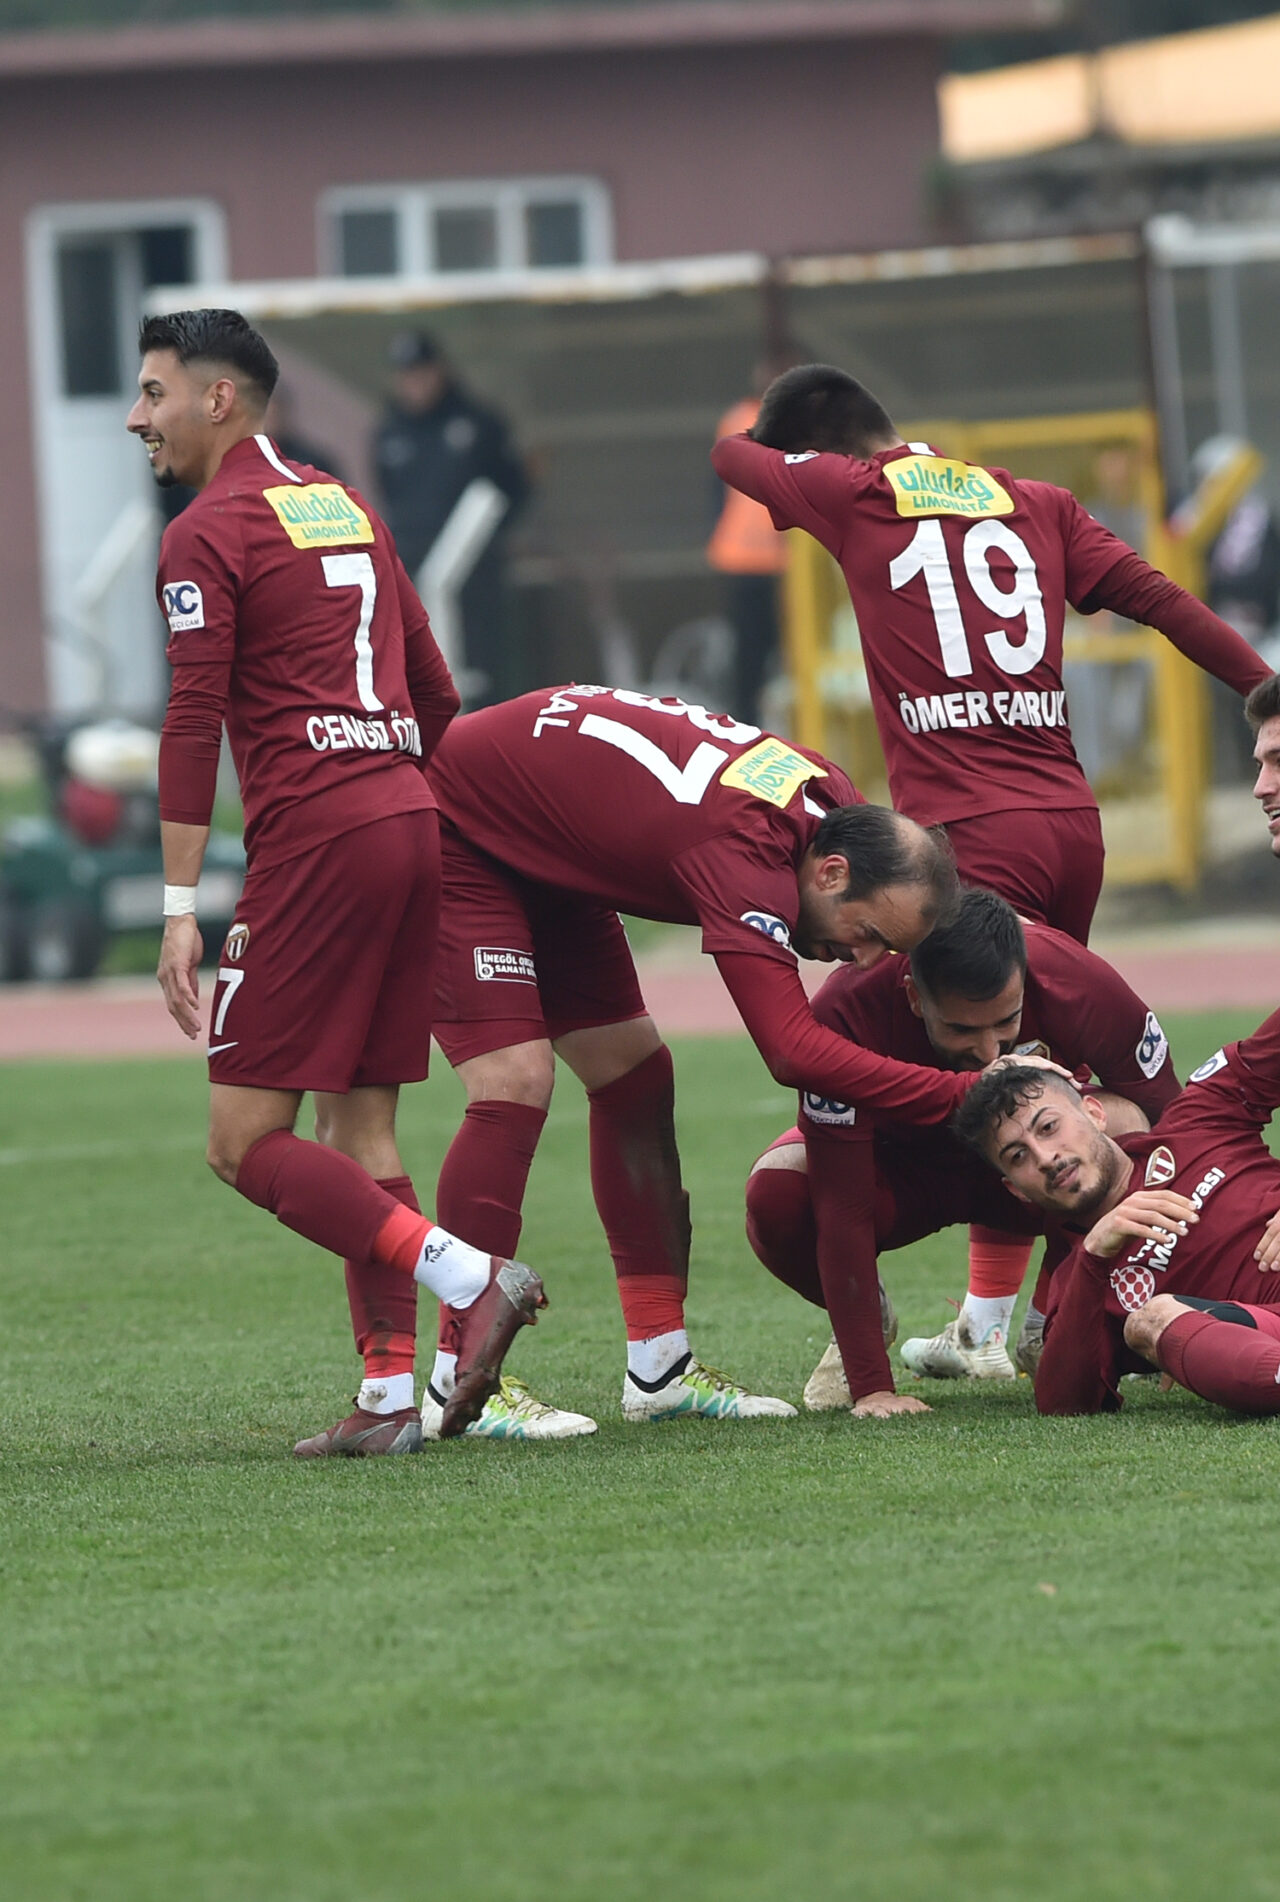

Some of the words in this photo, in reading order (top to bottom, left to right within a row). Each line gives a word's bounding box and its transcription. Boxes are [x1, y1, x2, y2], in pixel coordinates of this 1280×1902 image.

[278, 491, 361, 525] uludağ
[888, 518, 1047, 678] 19
[319, 552, 385, 712] 7
[306, 714, 395, 752] CENGİZ
[898, 691, 994, 734] ÖMER
[577, 687, 763, 806] 87
[482, 951, 518, 966] İNEGÖL
[213, 967, 245, 1036] 7
